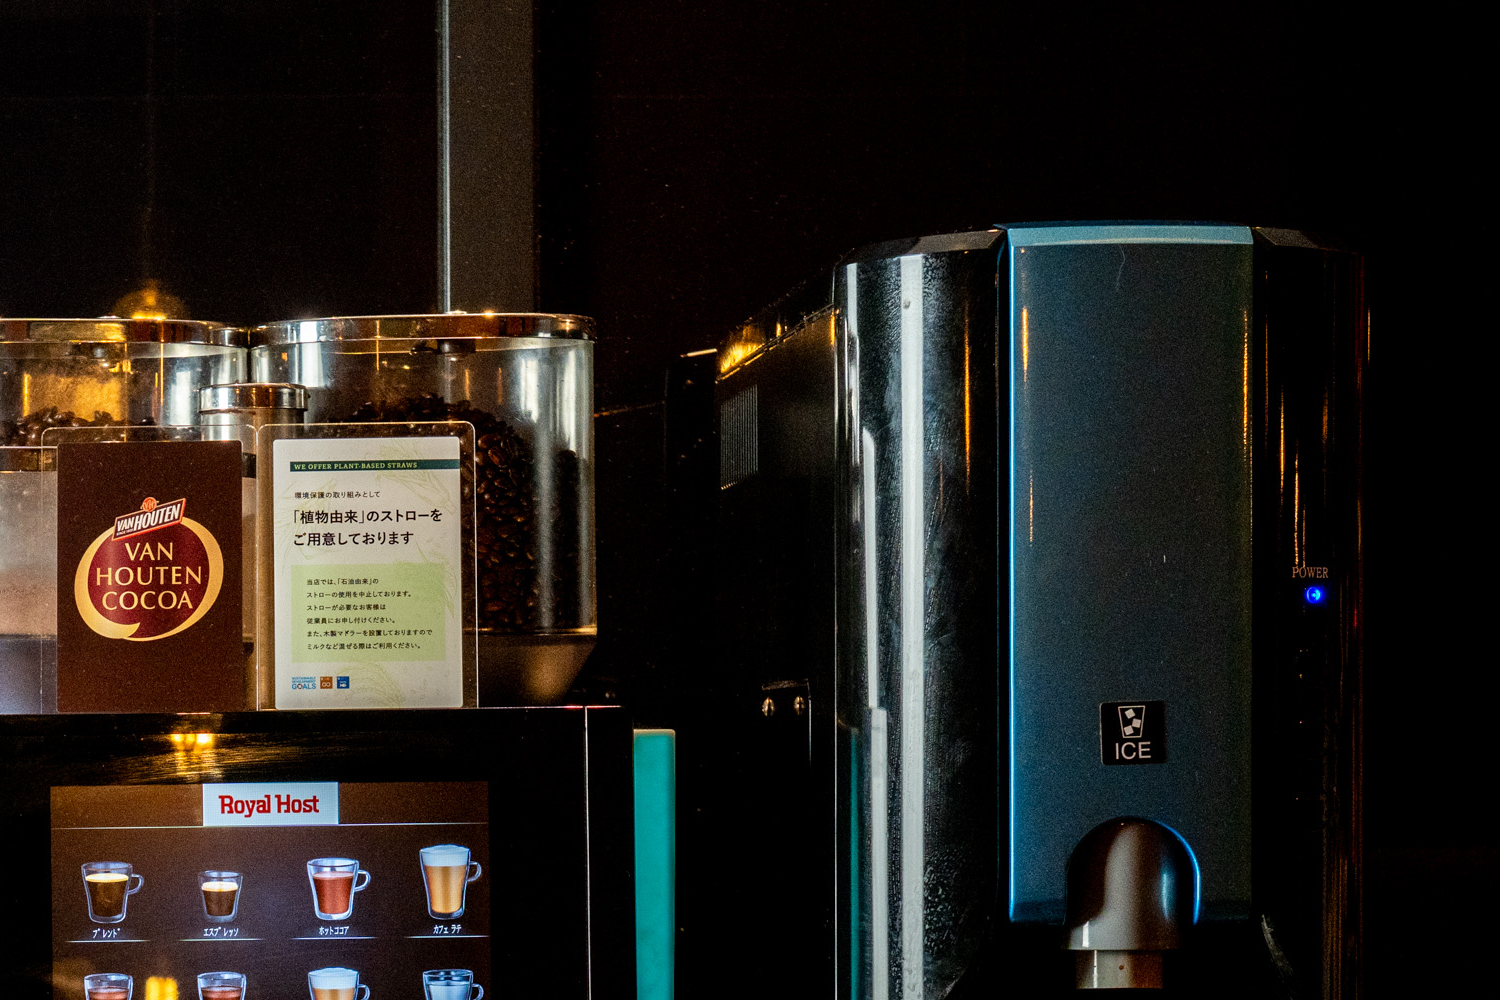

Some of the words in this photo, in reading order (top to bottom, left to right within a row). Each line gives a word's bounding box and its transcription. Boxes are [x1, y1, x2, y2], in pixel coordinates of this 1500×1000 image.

[333, 462, 386, 470] PLANT-BASED
[386, 461, 418, 469] STRAWS
[294, 491, 381, 500] 環境保護の取り組みとして
[117, 516, 135, 533] VAN
[132, 503, 182, 532] HOUTEN
[293, 508, 443, 525] 「植物由来」のストローを
[293, 531, 415, 547] ご用意しております
[124, 542, 173, 561] VAN
[96, 566, 202, 586] HOUTEN
[1291, 566, 1329, 578] POWER
[306, 577, 379, 586] 当店では、「石油由来」の
[102, 590, 194, 611] COCOA
[306, 590, 412, 599] ストローの使用を中止しております。
[306, 603, 387, 612] ストローが必要なお客様は
[306, 616, 396, 625] 従業員にお申し付けください。
[291, 683, 317, 692] GOALS
[1115, 741, 1152, 760] ICE
[218, 794, 271, 818] Royal
[274, 794, 320, 814] Host
[318, 926, 350, 935] ホットココア
